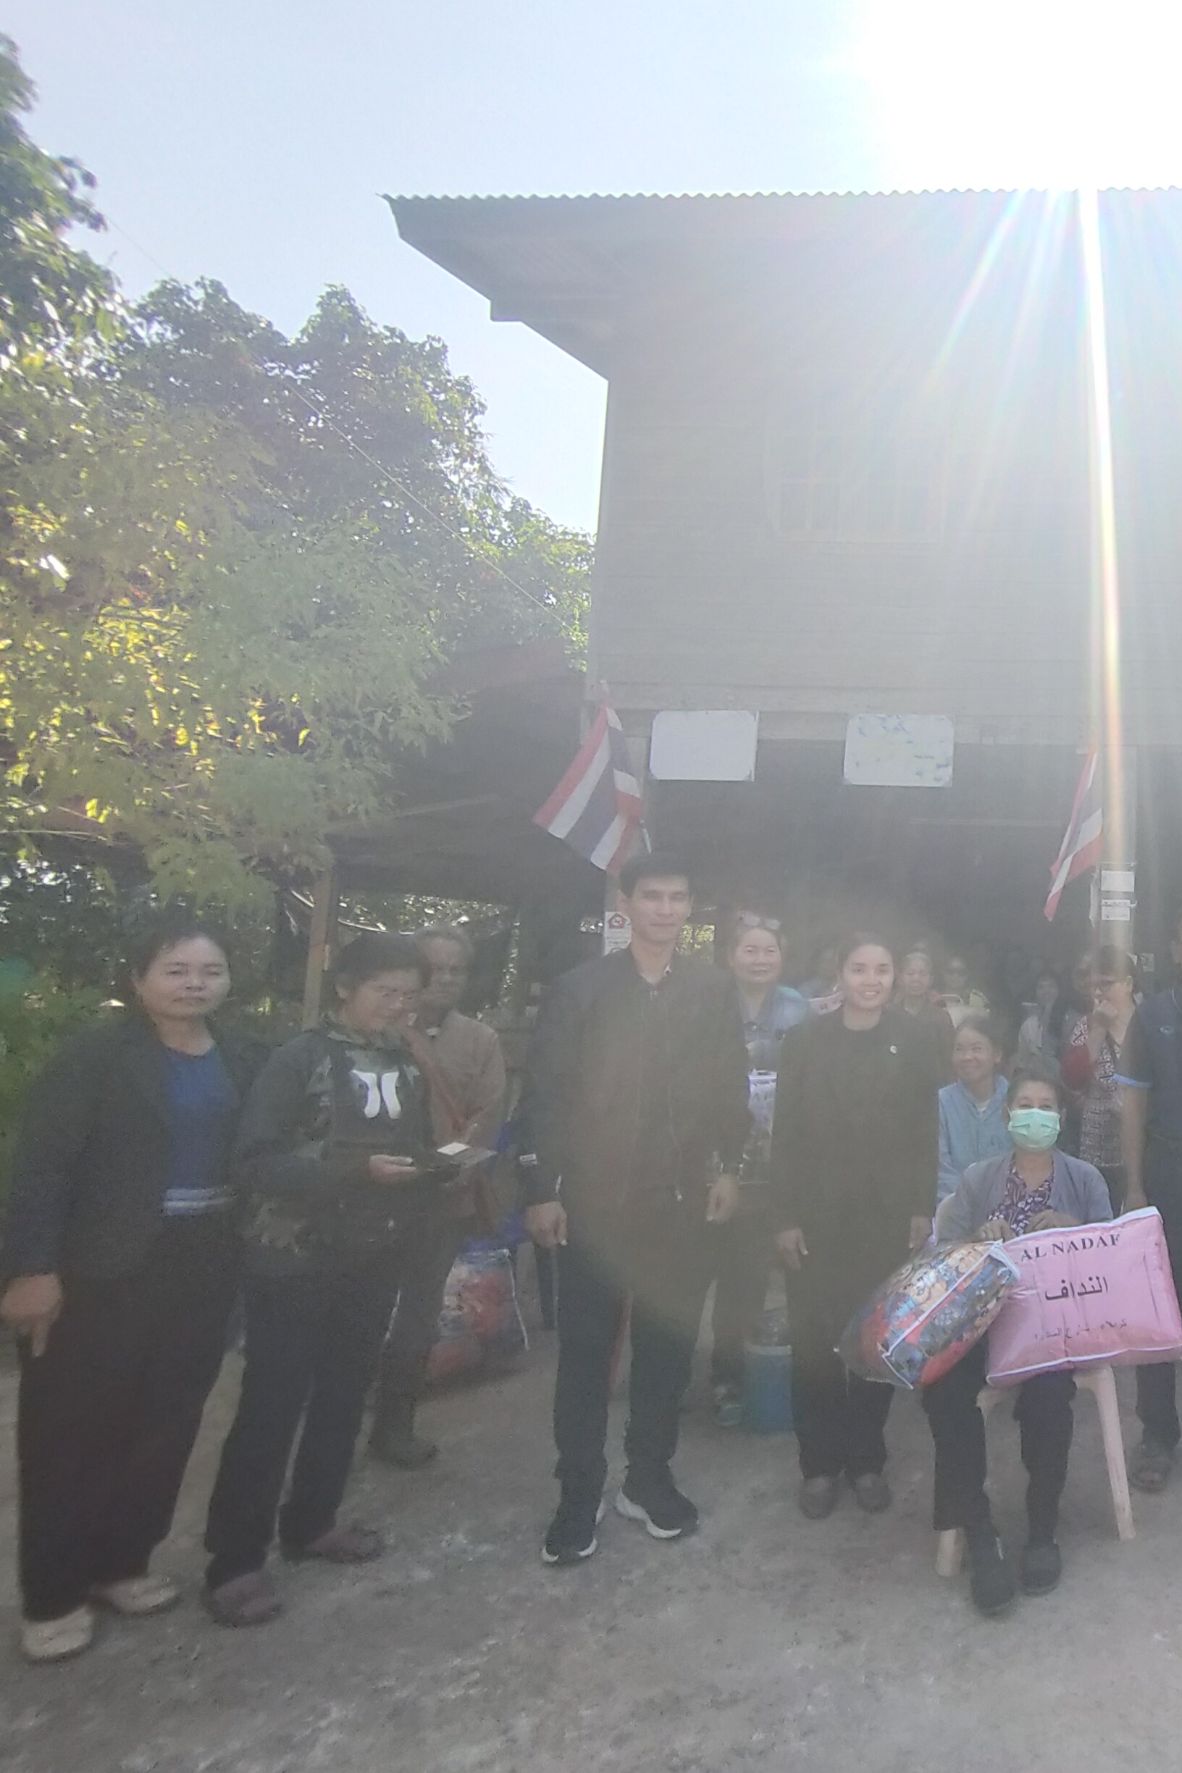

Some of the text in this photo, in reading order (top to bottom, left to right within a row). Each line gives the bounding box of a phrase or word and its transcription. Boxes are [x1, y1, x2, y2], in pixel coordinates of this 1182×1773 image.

[1020, 1233, 1122, 1263] AL NADAF
[1044, 1275, 1109, 1301] النداف
